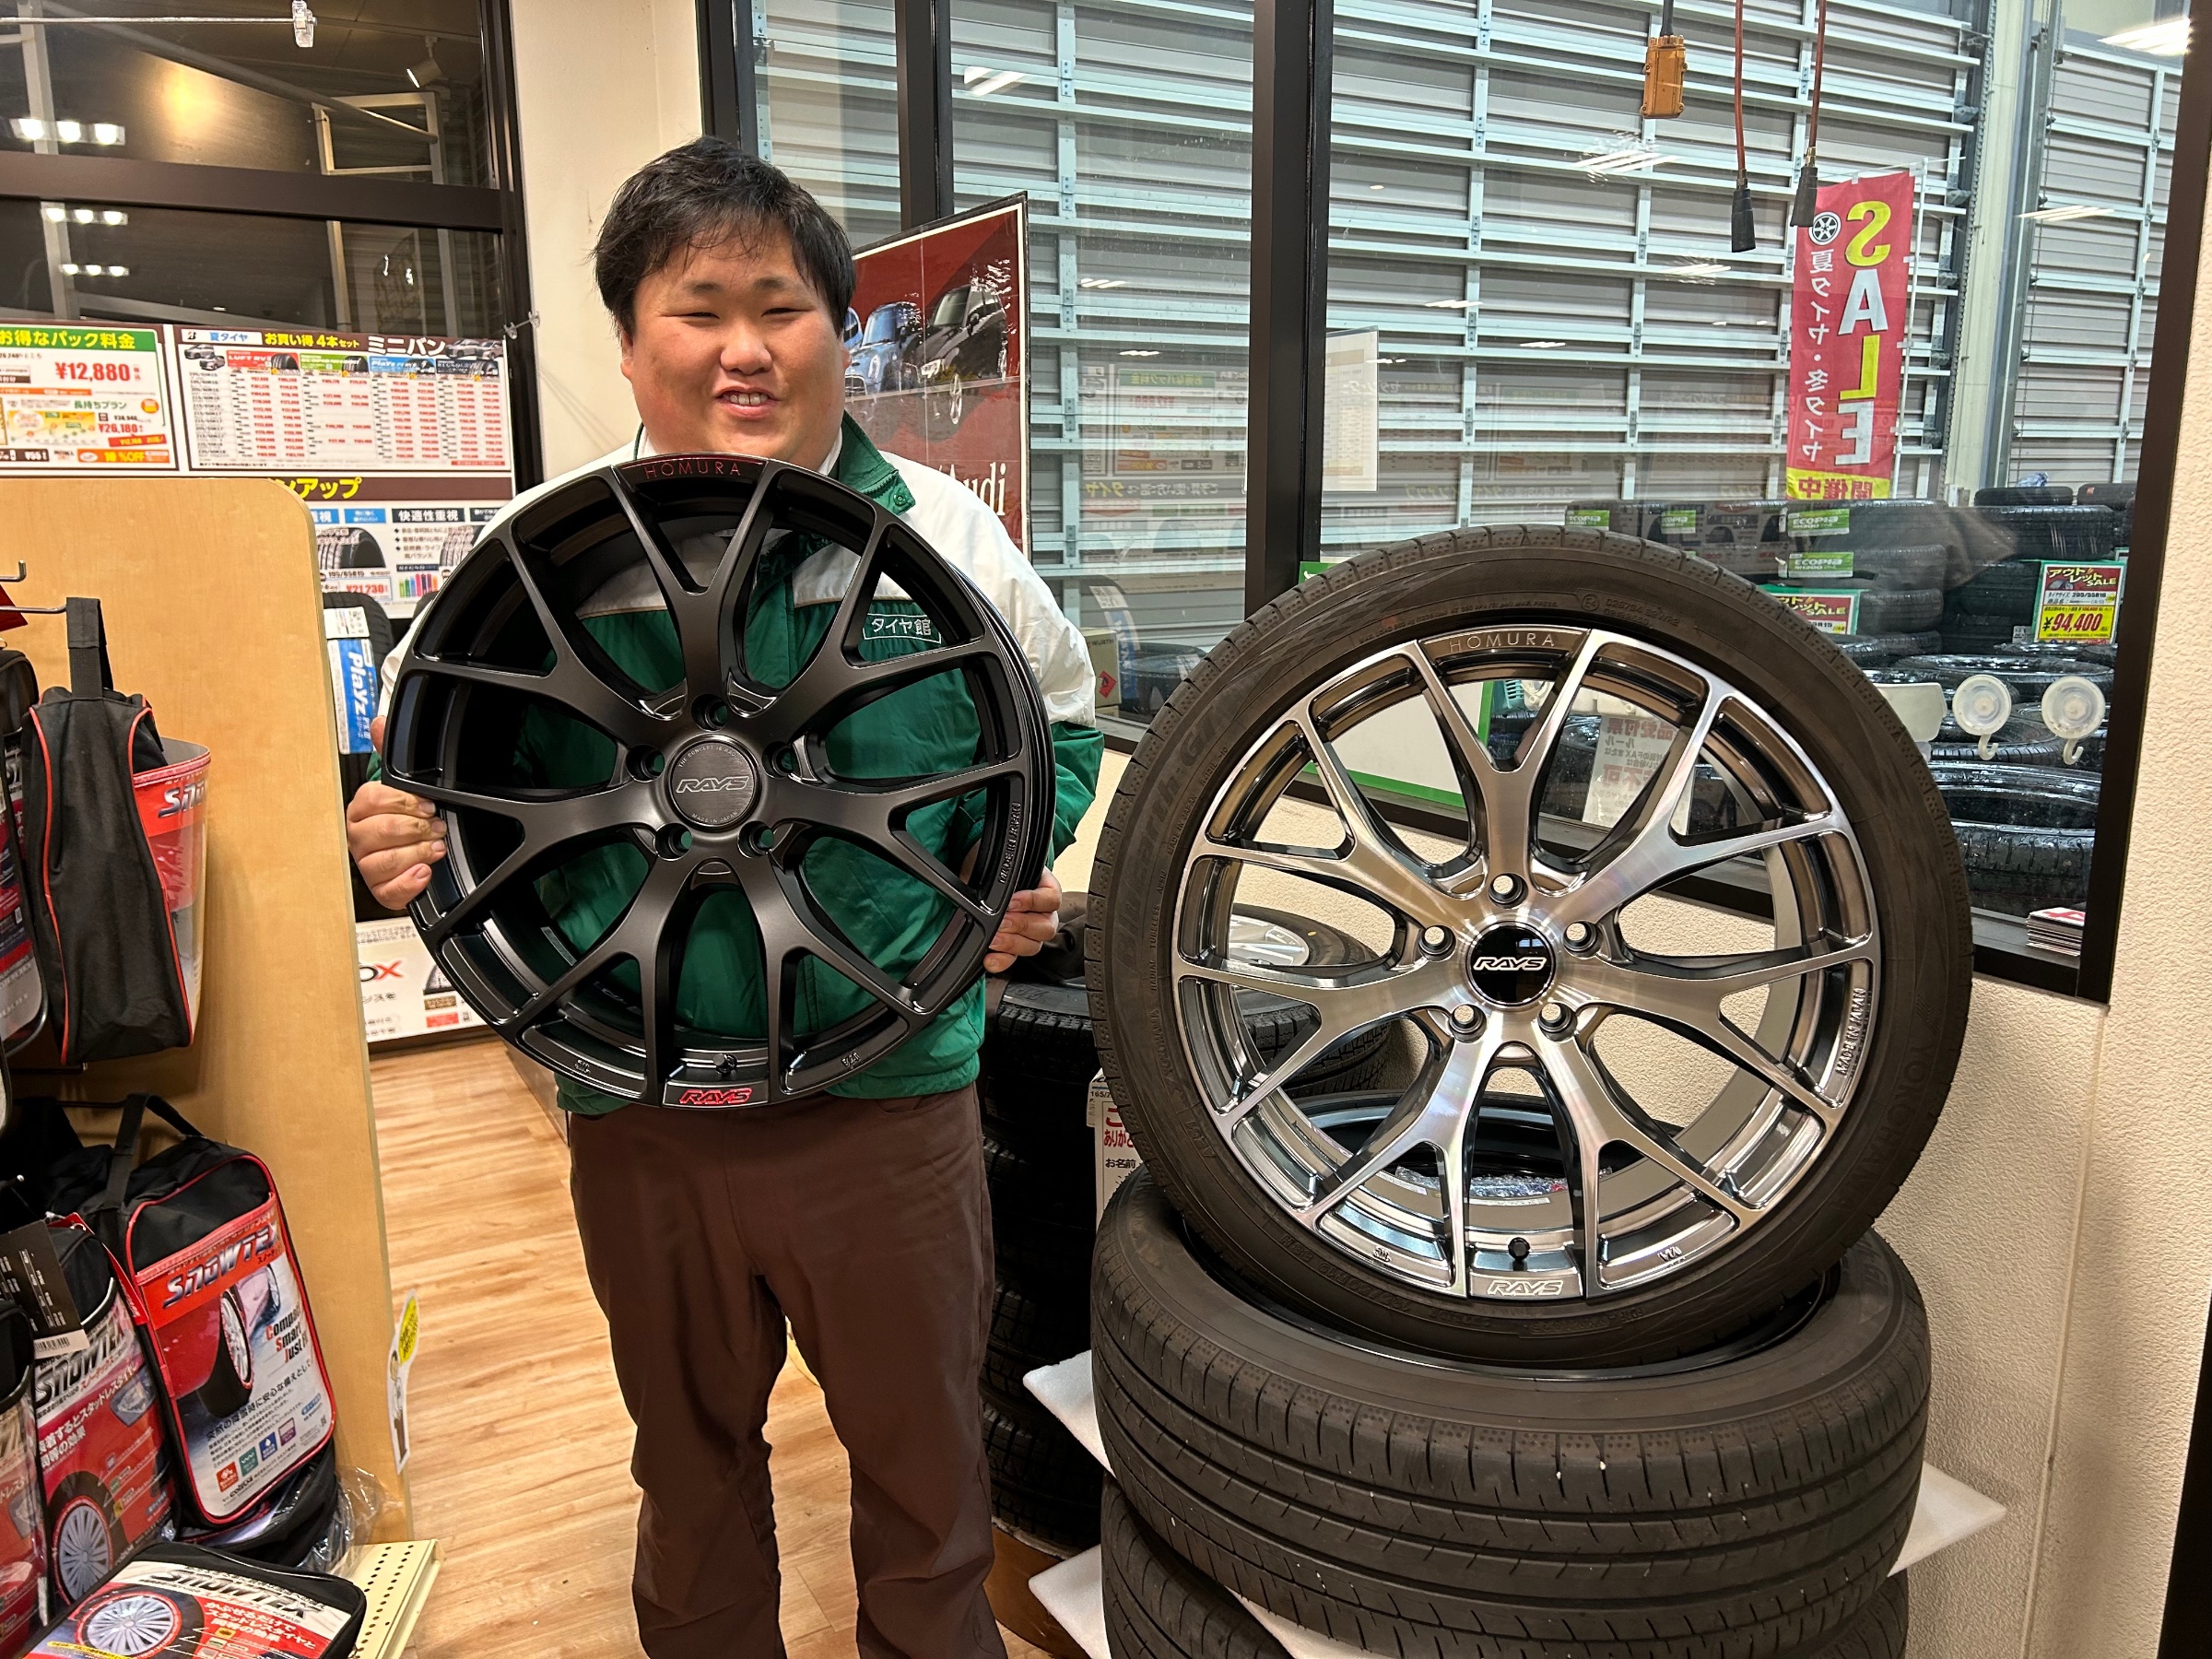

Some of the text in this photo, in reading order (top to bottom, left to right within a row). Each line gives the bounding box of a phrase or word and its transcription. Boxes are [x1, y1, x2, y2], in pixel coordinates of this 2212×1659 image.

[0, 329, 135, 349] お得なパック料金
[209, 332, 248, 342] 夏タイヤ
[369, 335, 446, 356] ミニバン
[55, 362, 131, 382] ¥12,880
[74, 400, 127, 410] 長持ちプラン
[644, 461, 741, 479] HOMURA
[398, 510, 459, 522] 快適性重視
[1792, 516, 1840, 526] ECOPIA
[1795, 557, 1843, 566] ECOPIA
[2048, 567, 2086, 579] アウト
[2069, 572, 2102, 583] レット
[2087, 577, 2117, 587] SALE
[1806, 606, 1846, 617] SALE
[872, 618, 932, 636] タイヤ館
[2043, 613, 2103, 633] ¥94,400
[1449, 633, 1556, 653] HOMURA
[676, 775, 750, 793] RAYS
[1178, 792, 1198, 821] JAPAN
[691, 813, 709, 823] MADE
[720, 811, 738, 823] JAPAN
[1173, 819, 1185, 831] IN
[1165, 830, 1181, 855] MADE
[1148, 902, 1161, 949] TUBELESS
[1473, 957, 1547, 971] RAYS
[1835, 987, 1866, 1077] MADE IN JAPAN
[678, 1087, 753, 1105] RAYS
[1105, 1159, 1136, 1170] お名前
[1486, 1280, 1564, 1297] RAYS
[204, 1601, 297, 1631] かぶせるだけで
[206, 1608, 317, 1650] スタッドレスタイヤと
